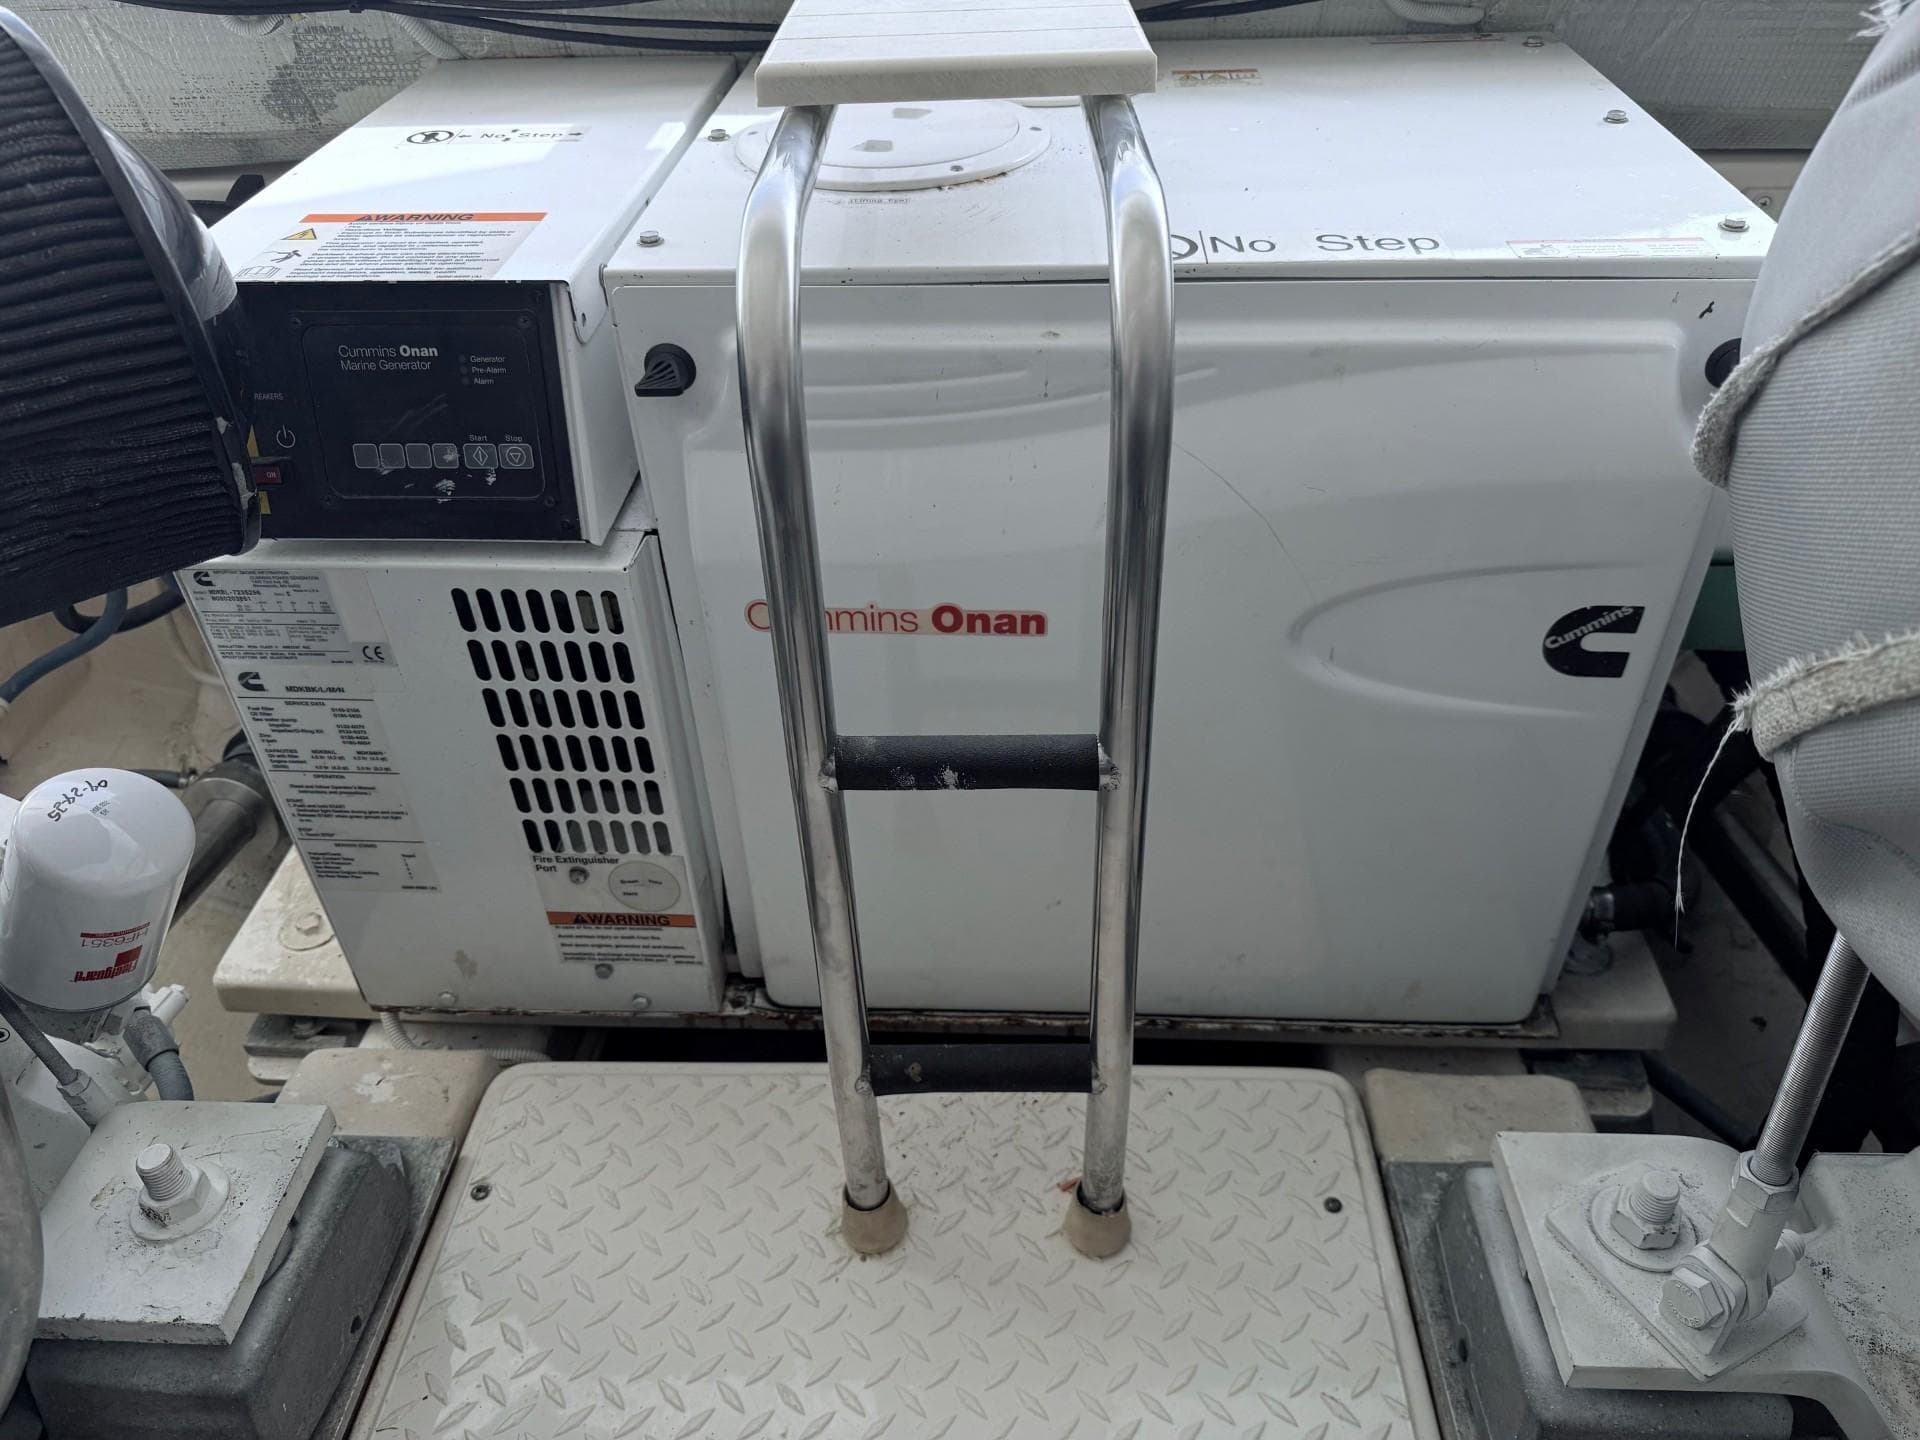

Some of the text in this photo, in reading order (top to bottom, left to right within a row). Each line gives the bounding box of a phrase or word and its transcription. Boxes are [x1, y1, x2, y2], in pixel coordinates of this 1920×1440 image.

[375, 213, 474, 222] WARNING
[1209, 233, 1441, 256] No Step
[338, 345, 438, 358] Cummins Onan
[470, 355, 505, 363] Generator
[340, 360, 431, 371] Marine Generator
[474, 377, 494, 385] Alarm
[253, 392, 284, 401] REAKERS
[469, 434, 488, 442] Start
[505, 434, 523, 444] Stop
[747, 602, 1046, 636] Cmins Onan
[1544, 606, 1634, 649] Cummins
[533, 856, 619, 866] Fire Extinguisher
[535, 864, 558, 873] Port
[586, 914, 671, 927] WARNING
